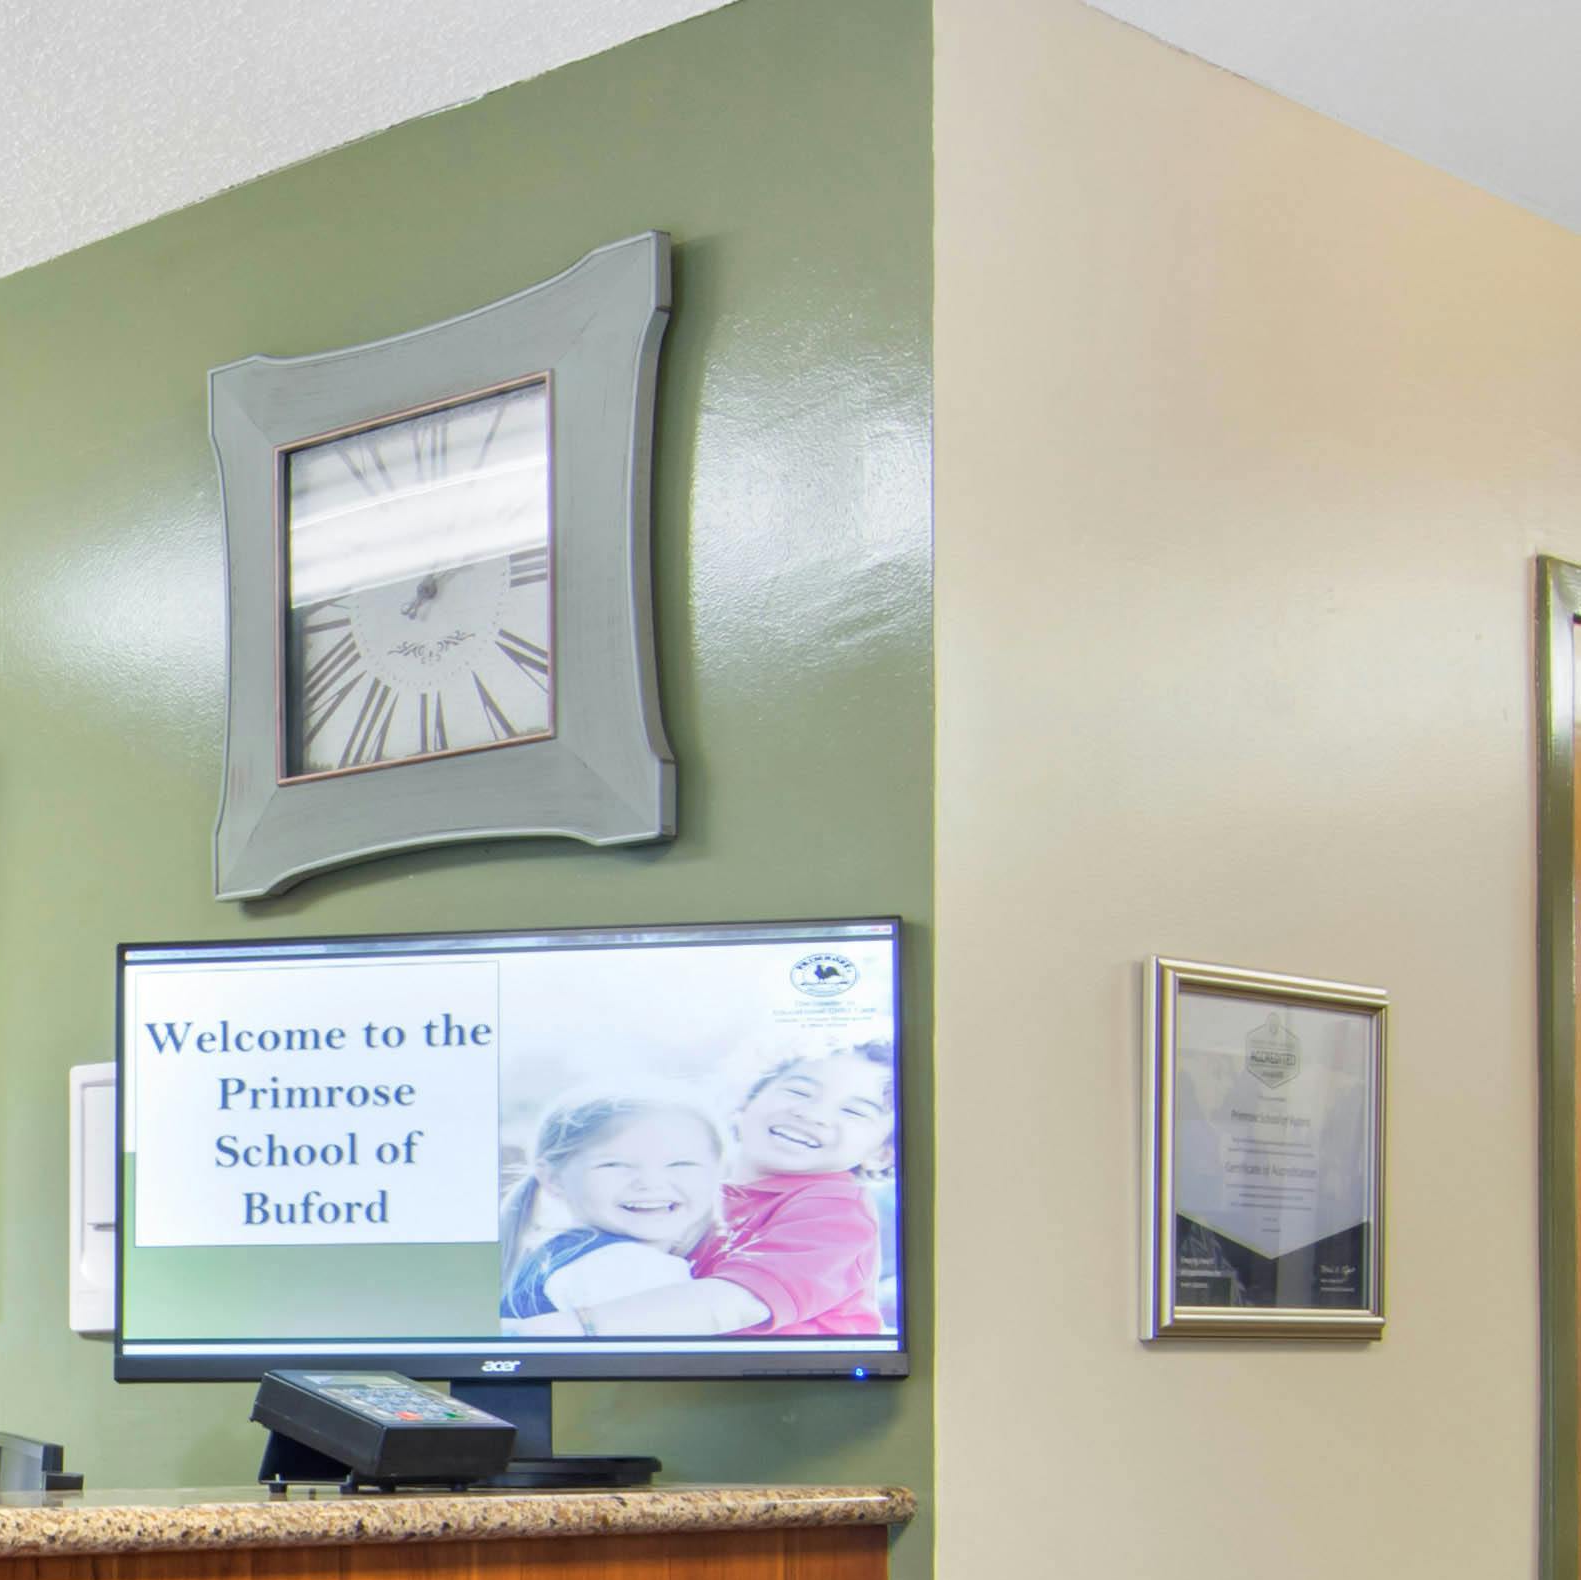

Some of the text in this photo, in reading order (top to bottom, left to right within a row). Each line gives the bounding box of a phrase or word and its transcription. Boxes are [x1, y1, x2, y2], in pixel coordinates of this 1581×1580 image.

[144, 1013, 492, 1054] Welcome to the
[217, 1076, 416, 1110] Primrose
[215, 1130, 424, 1168] School of
[242, 1189, 389, 1225] Buford
[481, 1360, 521, 1372] acer
